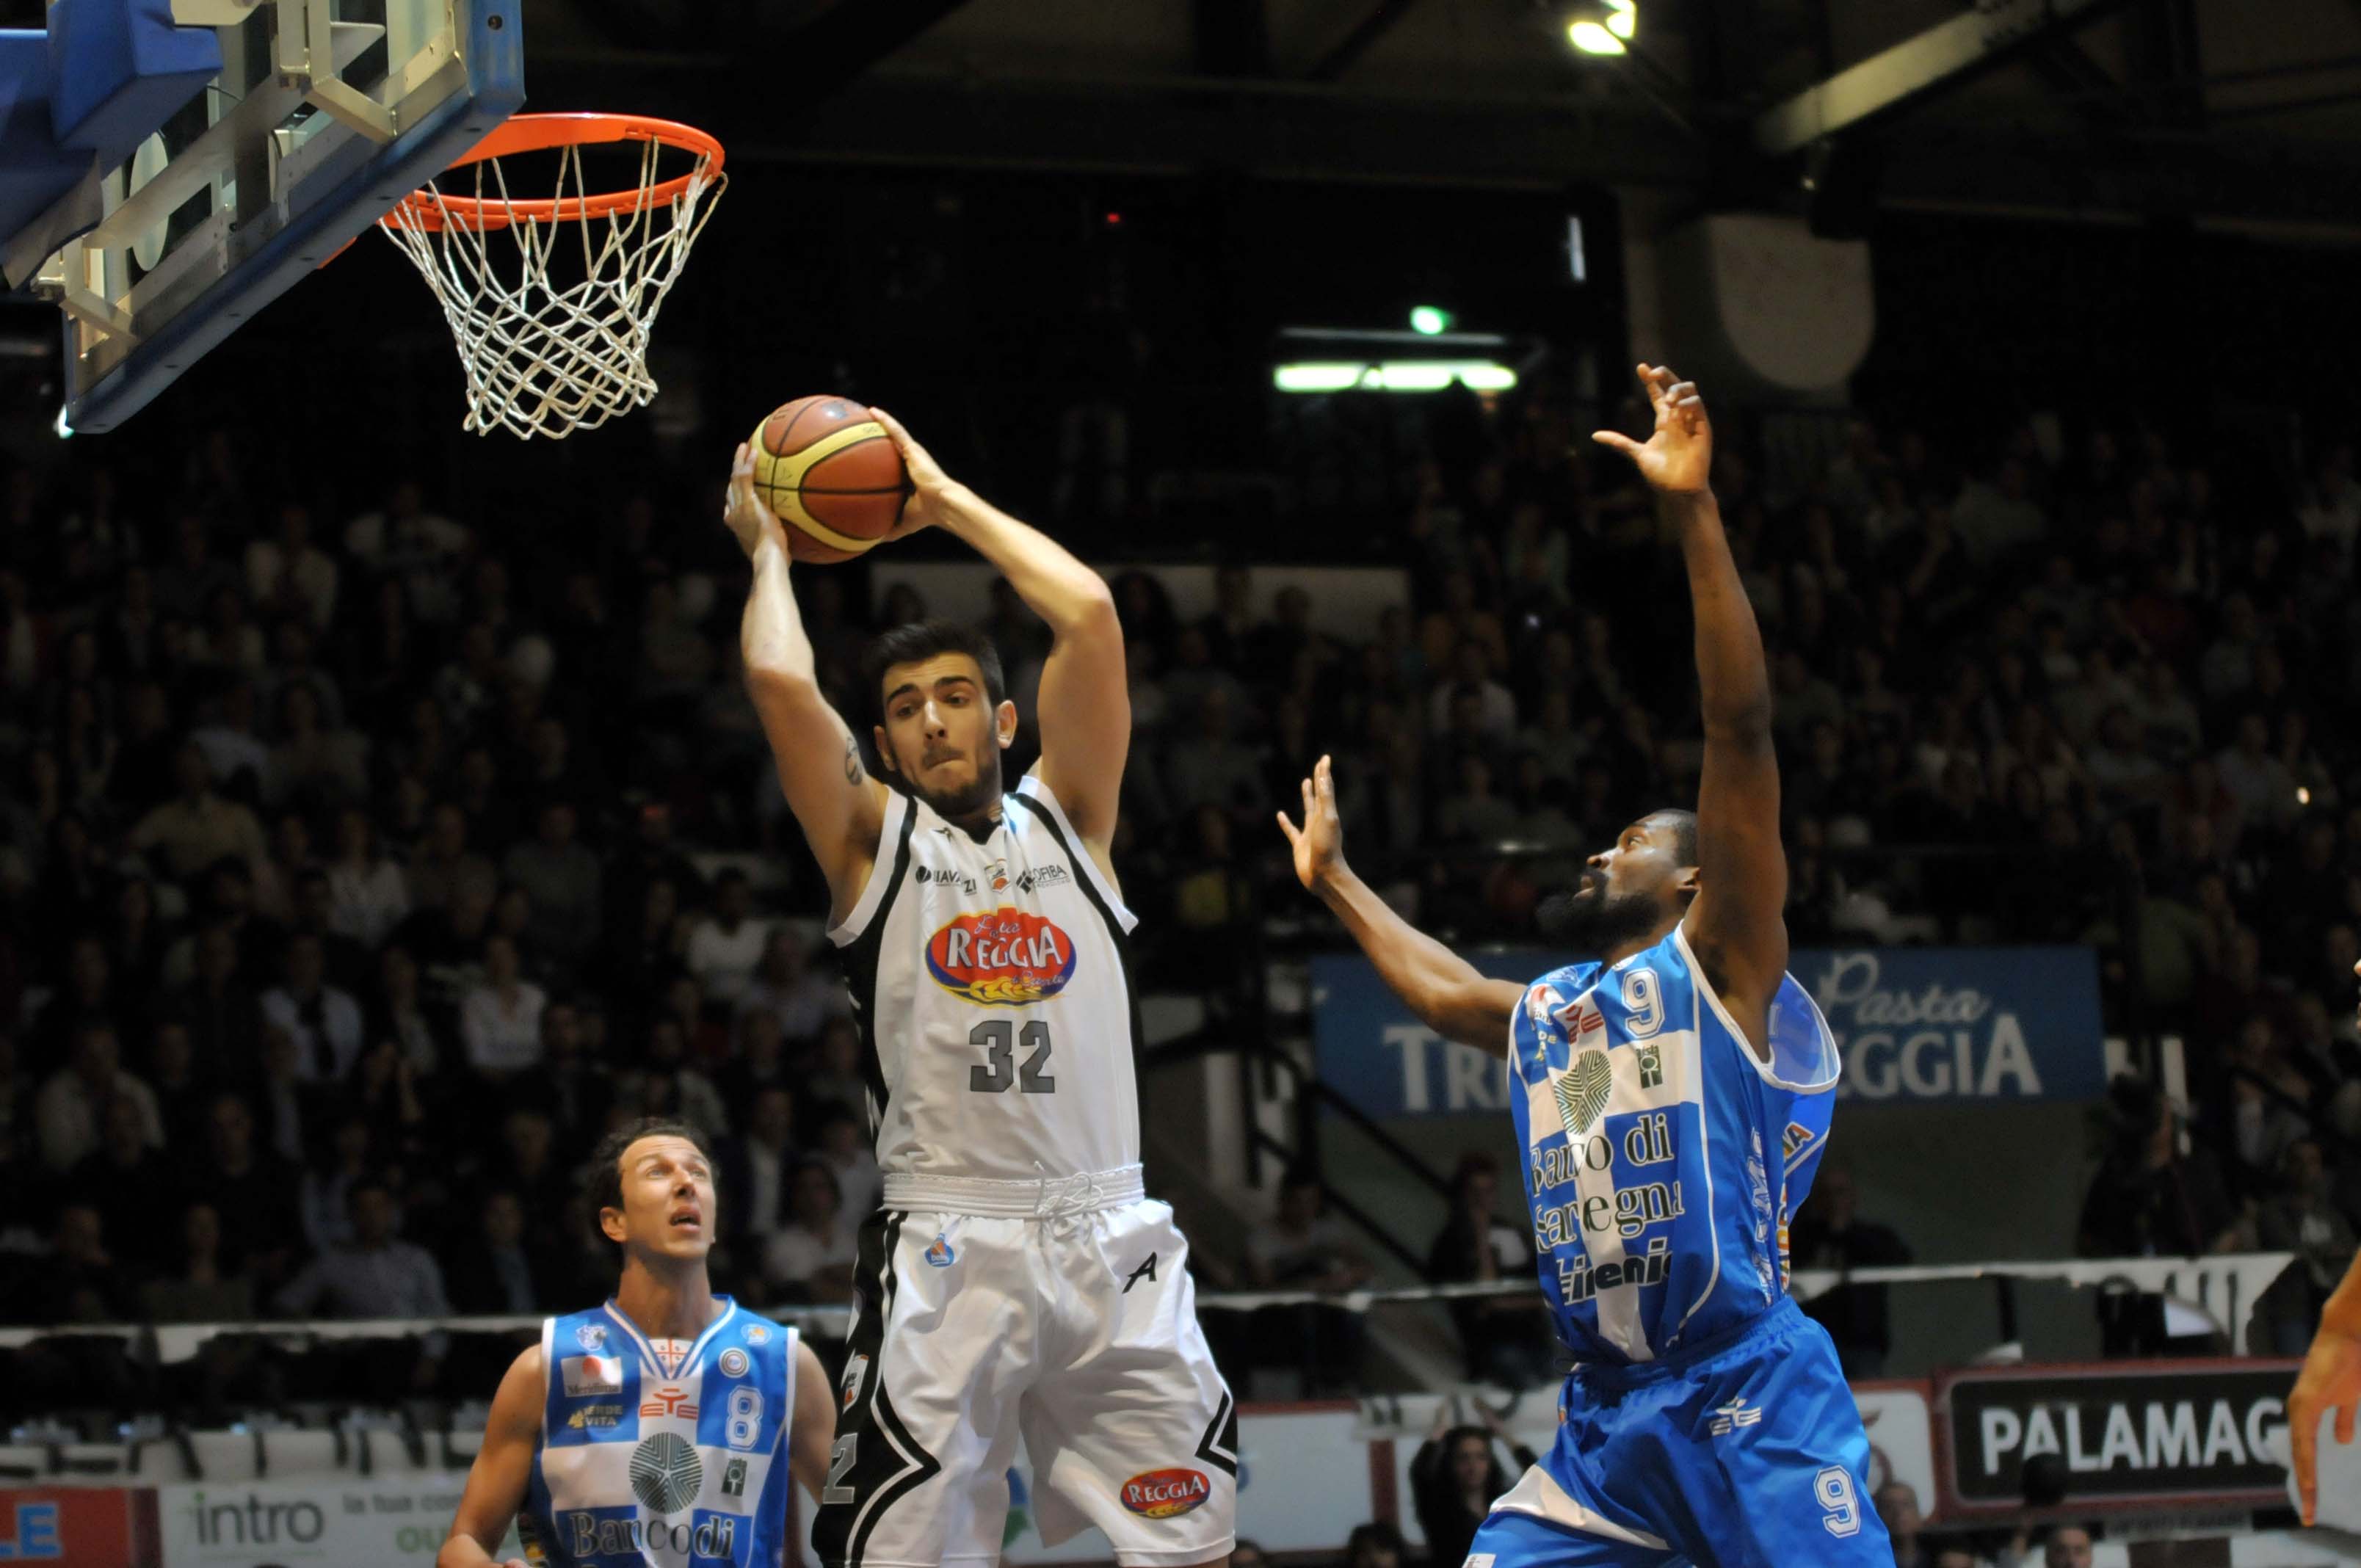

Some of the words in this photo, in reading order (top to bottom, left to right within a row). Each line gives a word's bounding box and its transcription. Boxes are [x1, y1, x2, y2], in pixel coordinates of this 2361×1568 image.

[947, 926, 1063, 969] REGGIA
[1621, 967, 1665, 1039] 9
[1816, 952, 1992, 1025] Pasta
[969, 1021, 1056, 1094] 32
[1837, 1012, 2042, 1098] GGIA
[1625, 1112, 1675, 1166] di
[586, 1416, 617, 1426] VITA
[725, 1384, 764, 1452] 8
[1981, 1397, 2288, 1476] PALAMAG
[194, 1491, 325, 1545] intro
[1128, 1475, 1205, 1503] REGGIA
[1813, 1464, 1861, 1539] 9
[0, 1503, 64, 1558] E
[570, 1511, 692, 1558] Banco
[694, 1514, 735, 1559] di
